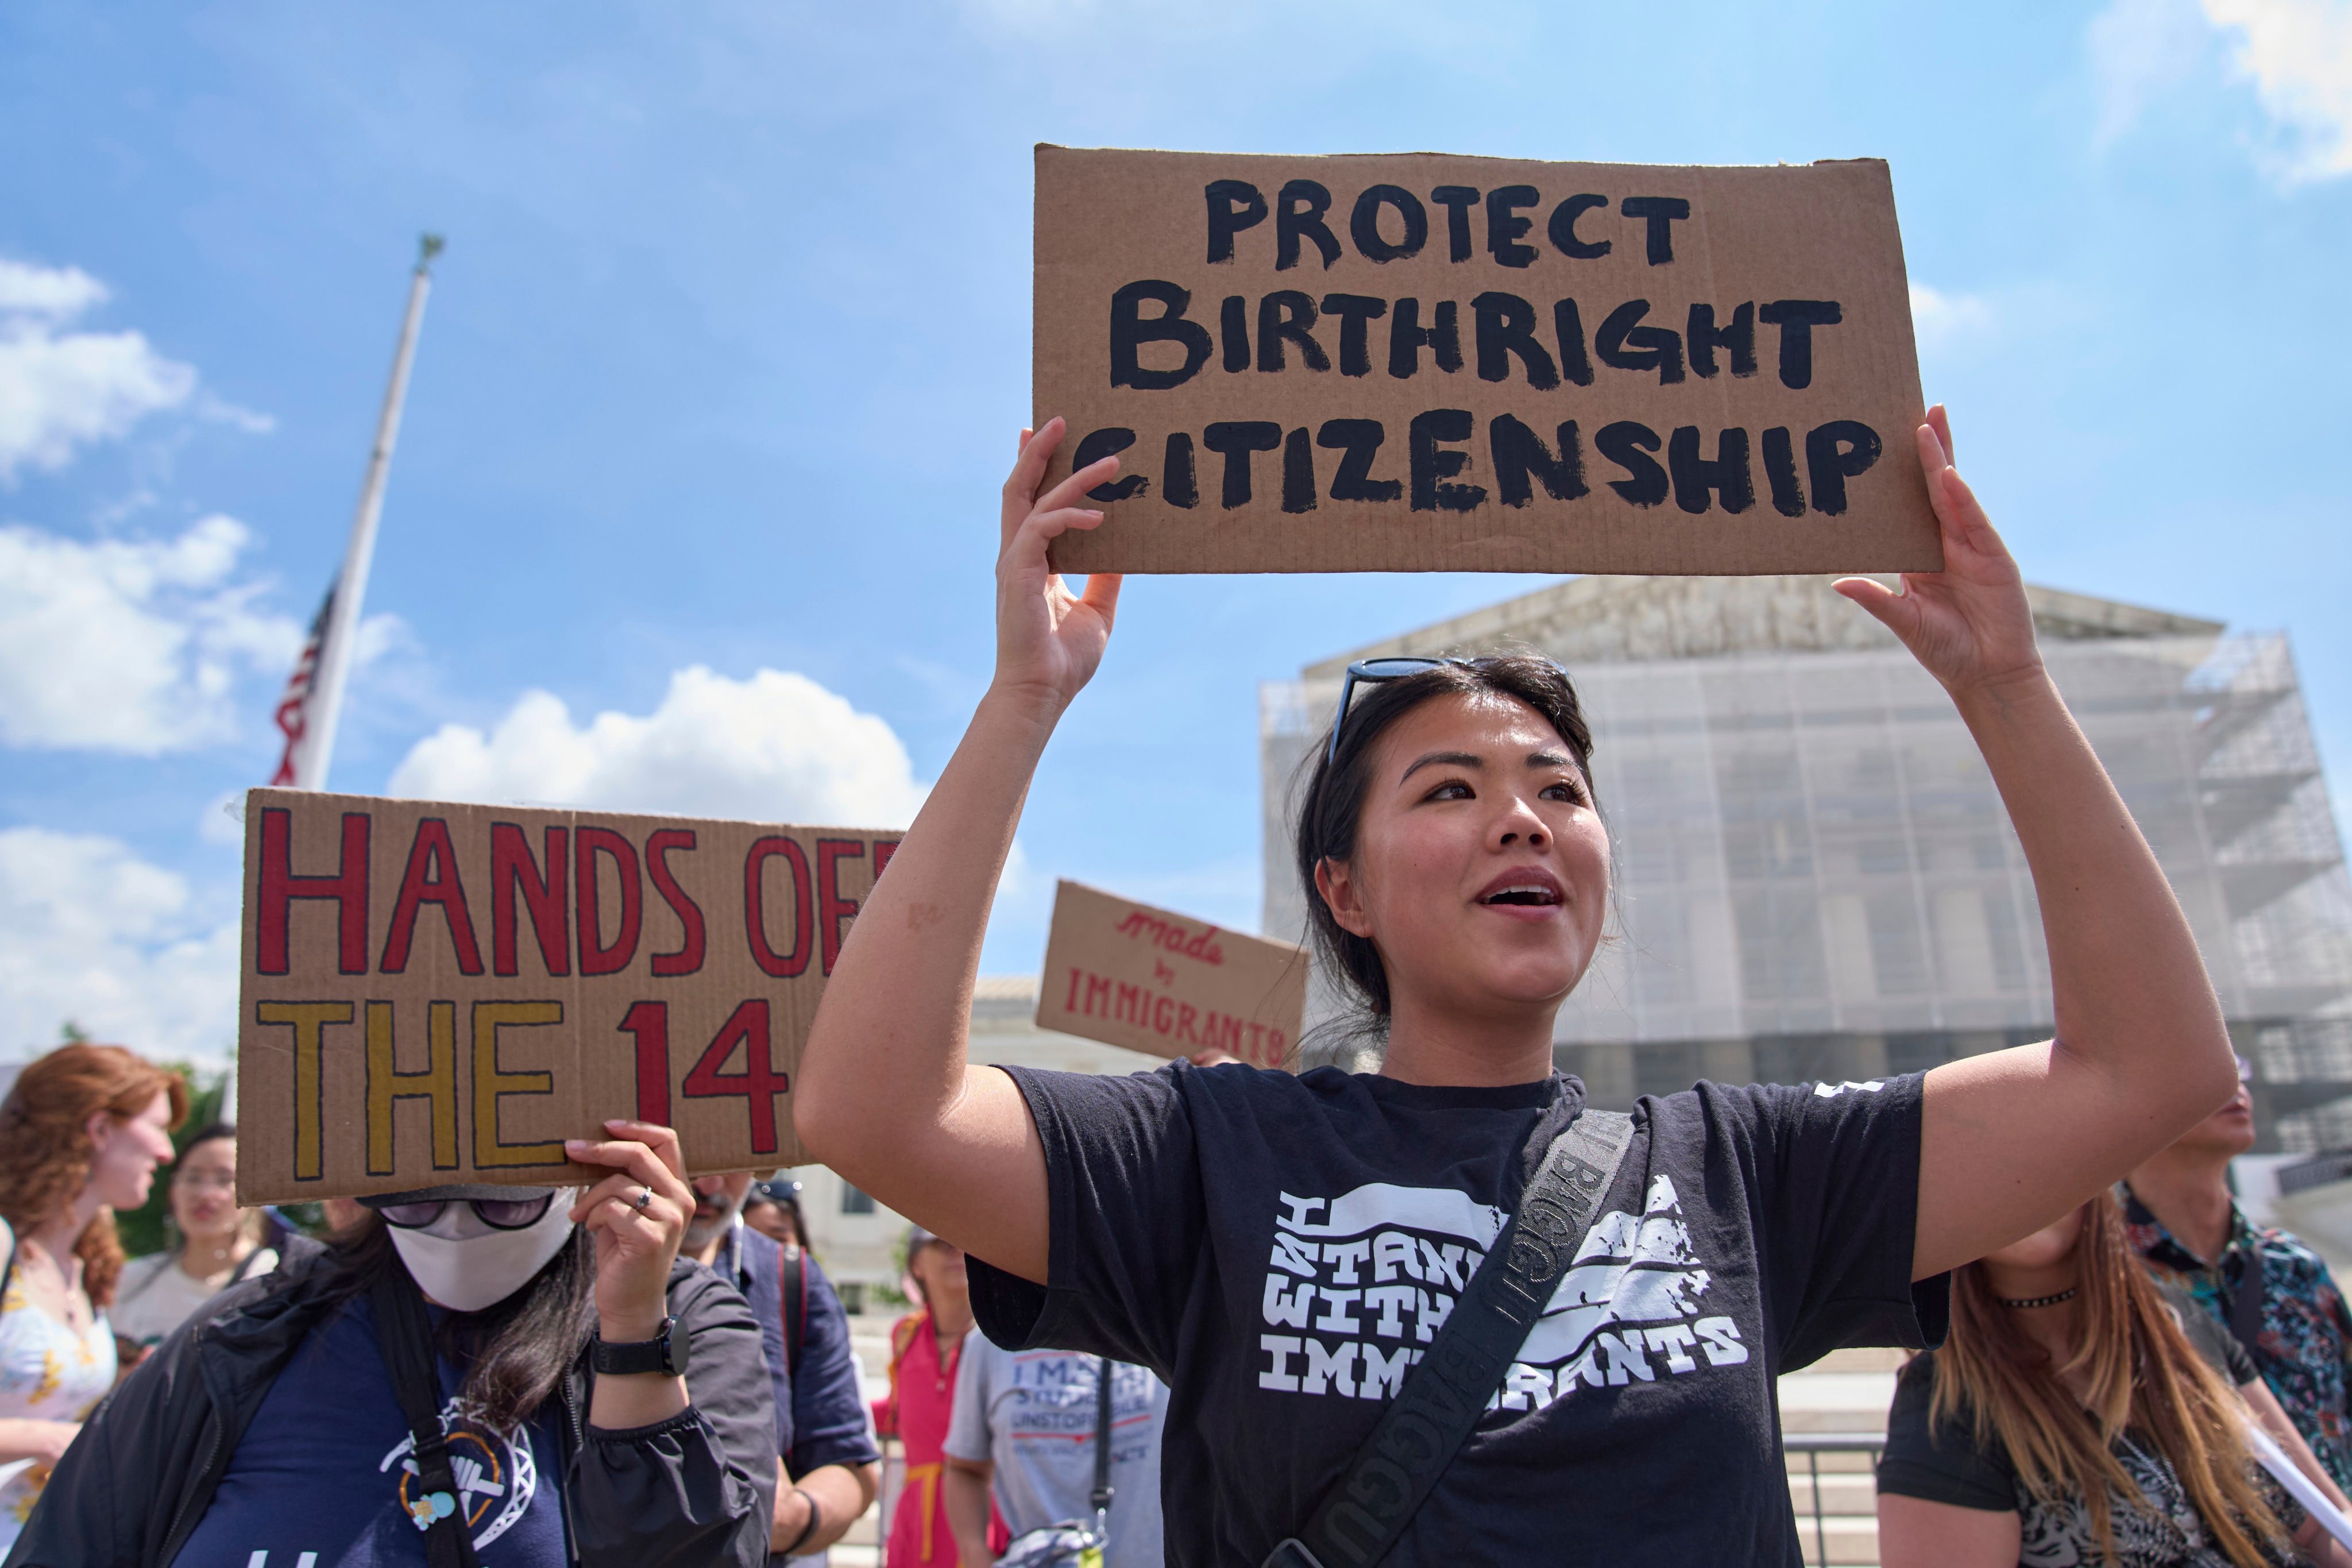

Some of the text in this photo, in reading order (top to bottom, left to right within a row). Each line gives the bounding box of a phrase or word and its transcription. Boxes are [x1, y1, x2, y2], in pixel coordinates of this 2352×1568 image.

[1205, 179, 1691, 271] PROTECT
[1110, 279, 1843, 392] BIRTHRIGHT
[1072, 408, 1883, 517] CITIZENSHIP
[256, 807, 901, 978] HANDS OF
[1116, 909, 1225, 966] made
[256, 999, 789, 1182] THE 14
[1480, 1149, 1606, 1324] BAGGU
[1259, 1316, 1749, 1411] IMMRANTS
[1326, 1330, 1500, 1565] BAGGU
